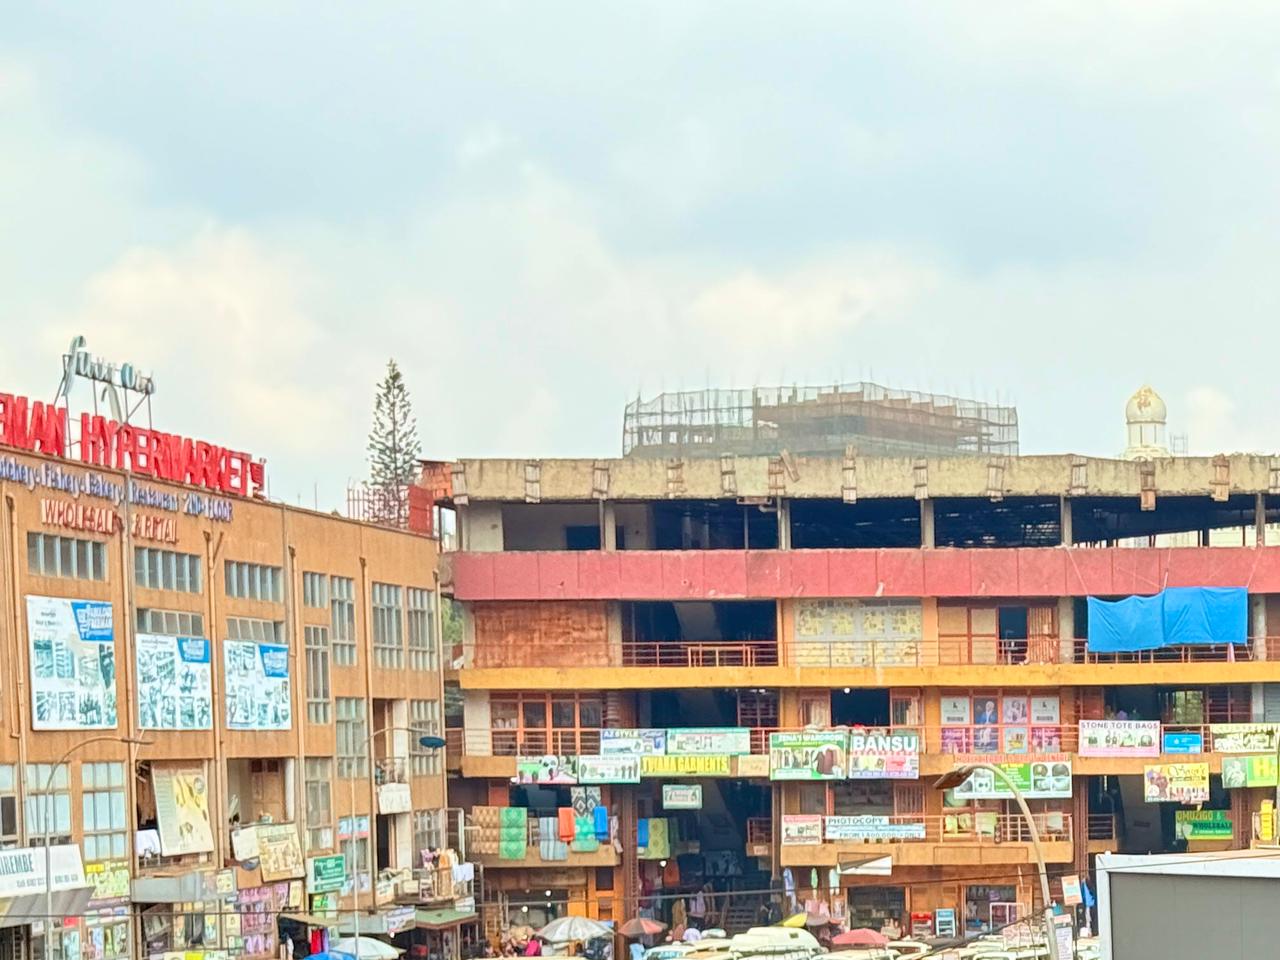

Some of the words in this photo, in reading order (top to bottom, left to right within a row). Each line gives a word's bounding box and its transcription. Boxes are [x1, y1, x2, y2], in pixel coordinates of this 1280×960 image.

[1081, 722, 1109, 730] STONE
[1110, 722, 1133, 730] TOTE
[853, 736, 916, 751] BANSU
